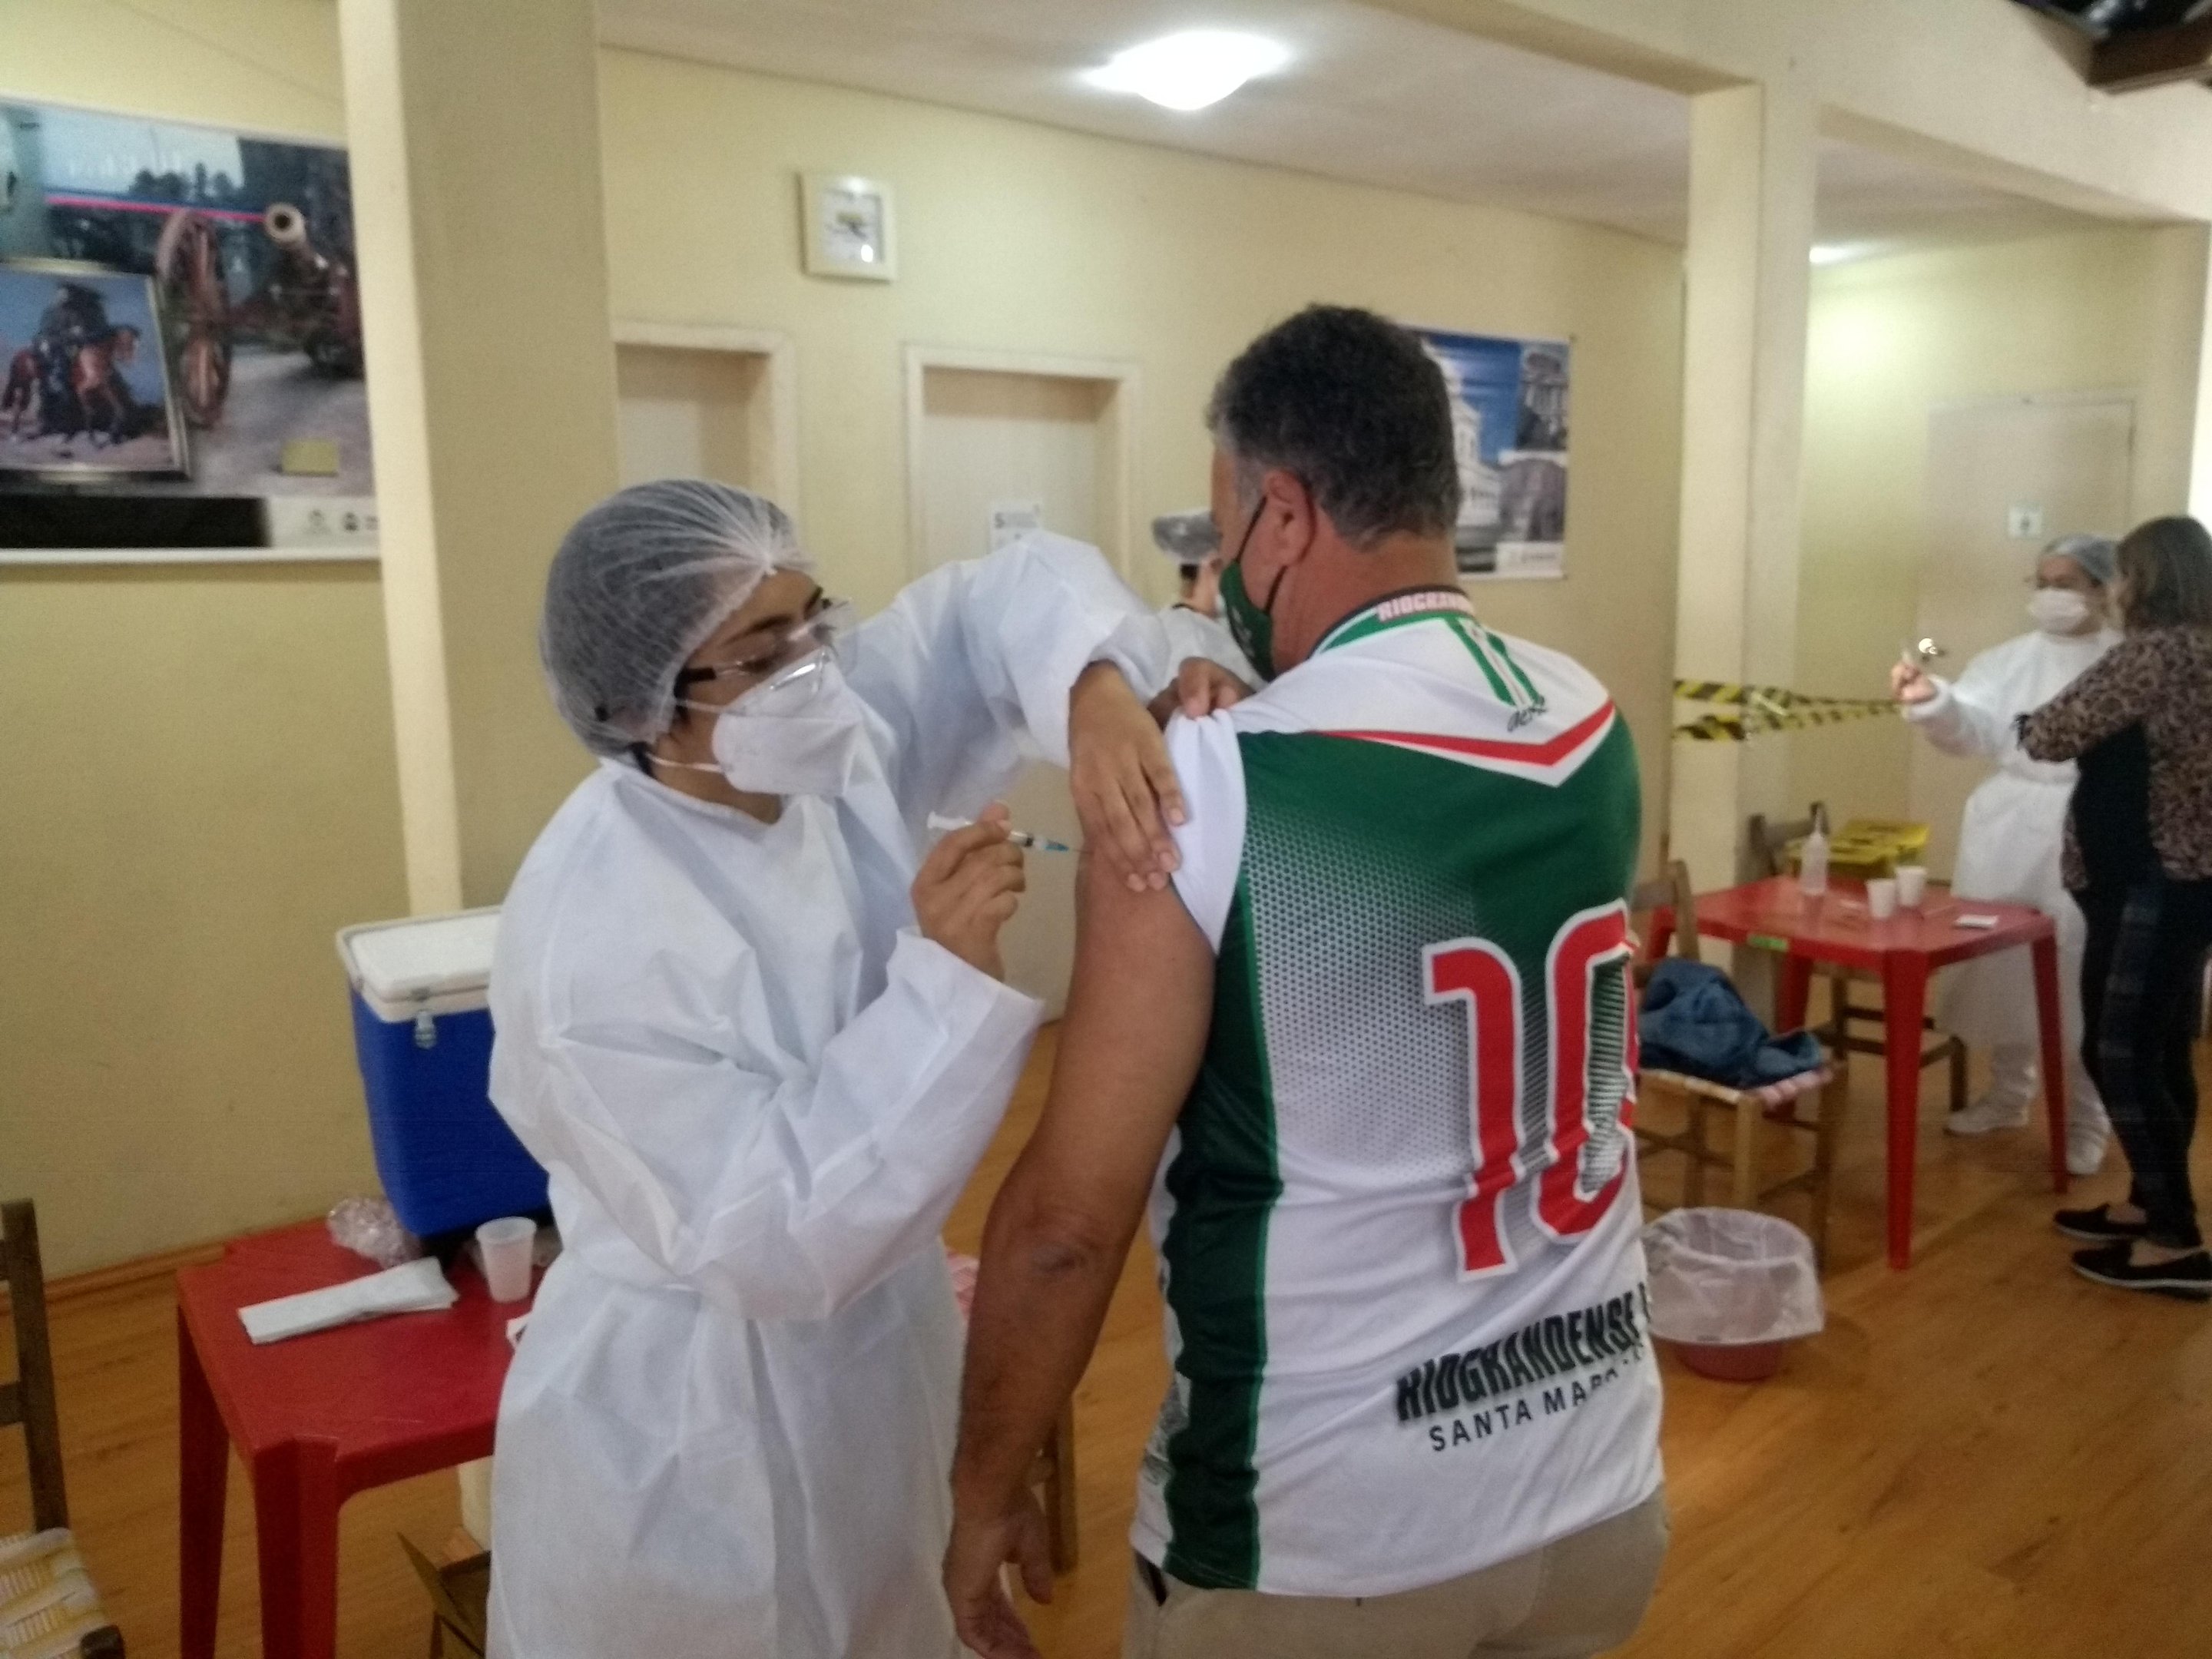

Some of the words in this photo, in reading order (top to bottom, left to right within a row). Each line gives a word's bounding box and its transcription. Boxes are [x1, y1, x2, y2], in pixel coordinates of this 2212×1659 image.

[1421, 898, 1640, 1281] 10
[1397, 1290, 1642, 1421] RIOGRANDENSE
[1429, 1399, 1532, 1451] SANTA
